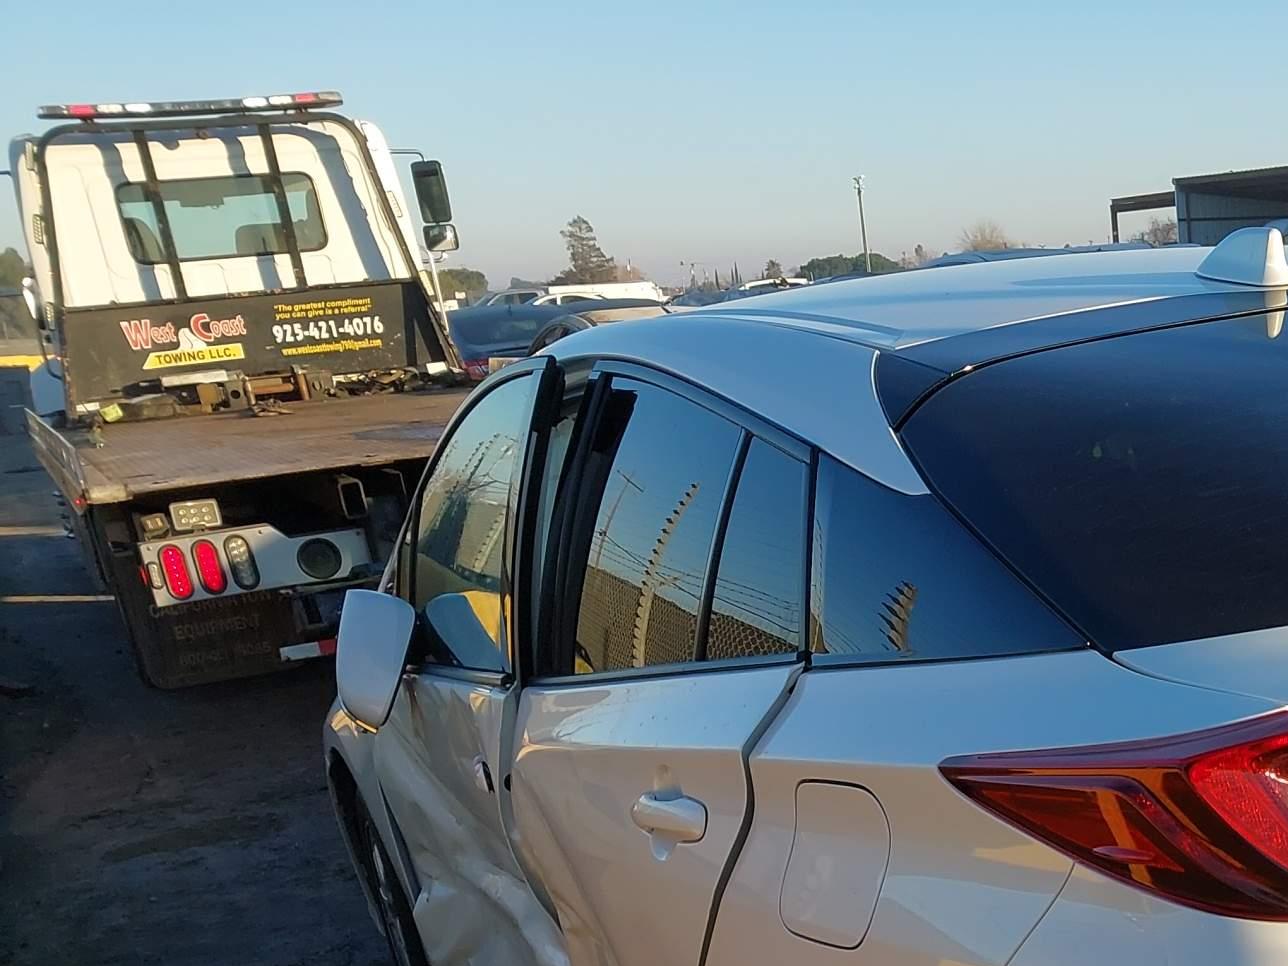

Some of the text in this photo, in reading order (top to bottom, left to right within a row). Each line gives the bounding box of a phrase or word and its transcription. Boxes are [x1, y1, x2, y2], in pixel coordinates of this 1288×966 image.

[294, 301, 325, 311] greatest
[326, 298, 371, 309] compliment
[275, 312, 290, 321] you
[292, 310, 306, 318] can
[307, 307, 324, 318] give
[325, 307, 333, 315] is
[119, 313, 247, 351] West Coast
[271, 316, 384, 343] 925-421-4076
[154, 350, 206, 365] TOWING
